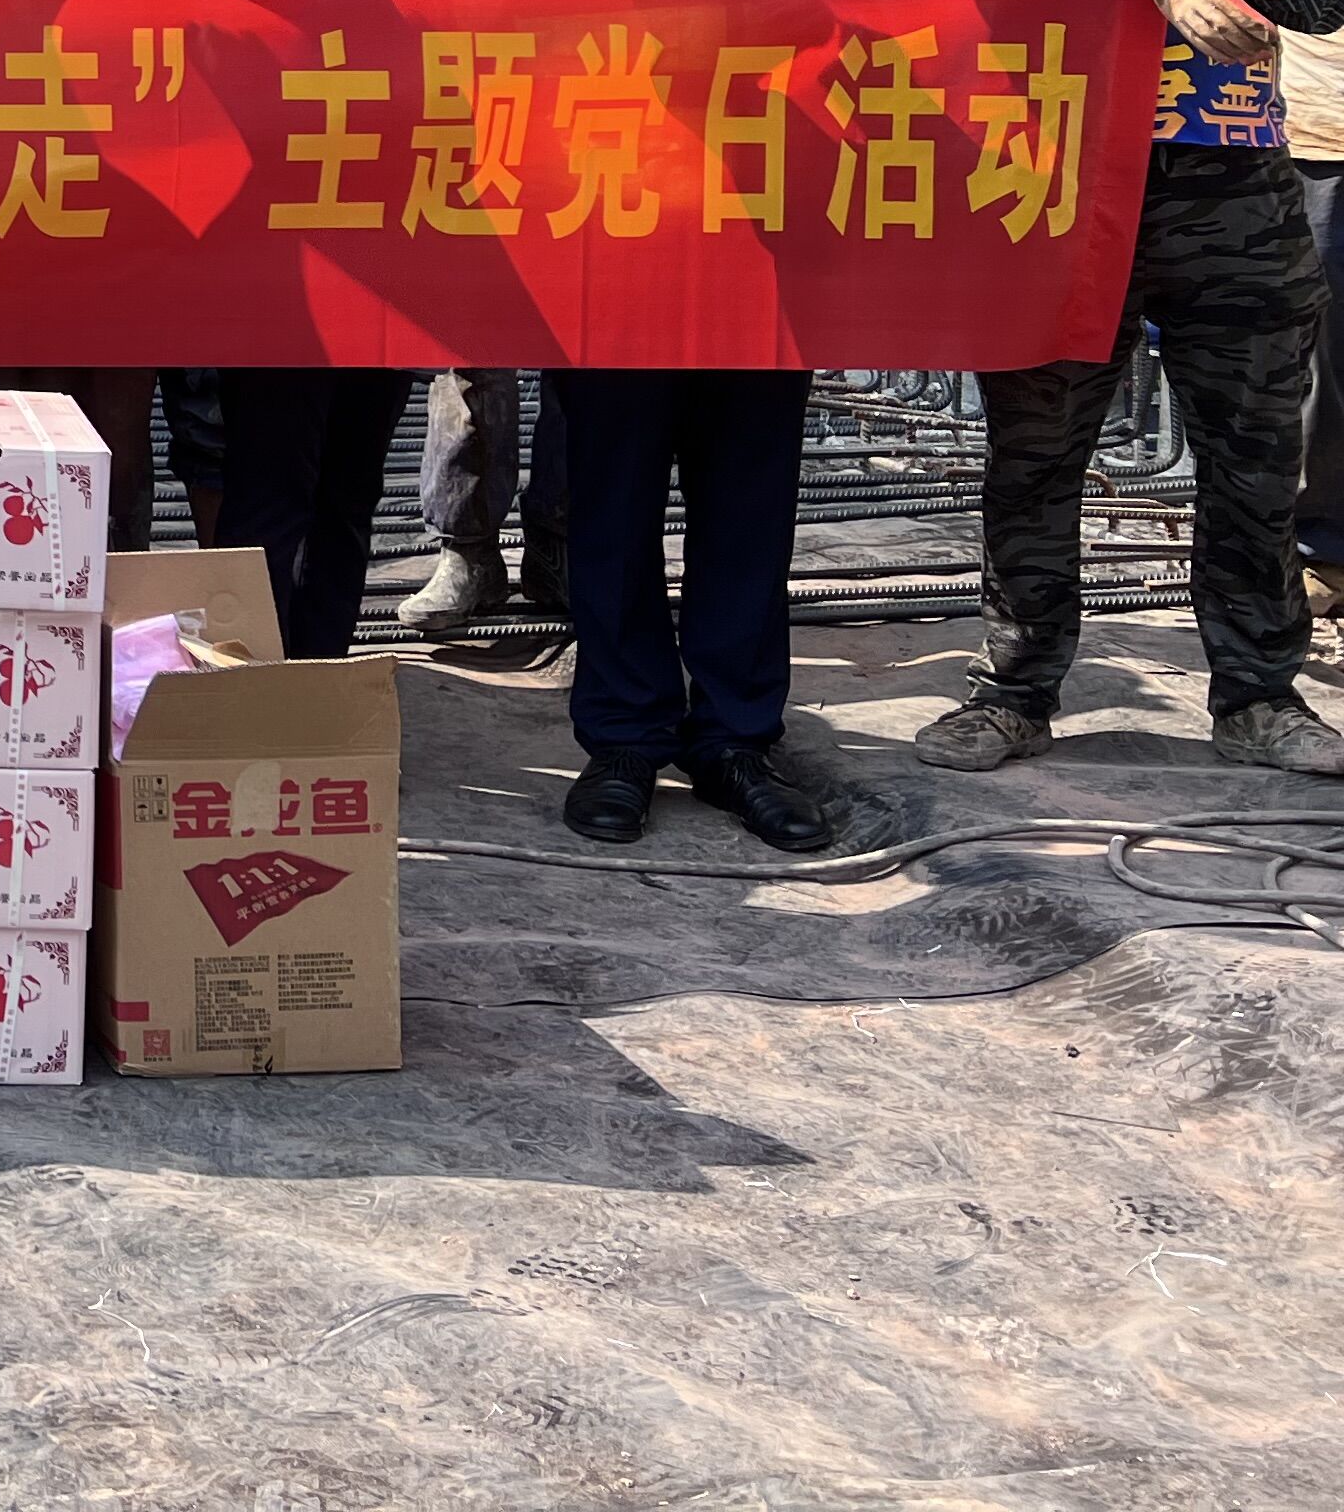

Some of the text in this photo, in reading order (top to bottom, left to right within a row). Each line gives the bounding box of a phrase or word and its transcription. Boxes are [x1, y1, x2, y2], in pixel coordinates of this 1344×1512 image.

[267, 21, 1090, 246] 主题党日活动
[216, 857, 300, 899] 1:1:1
